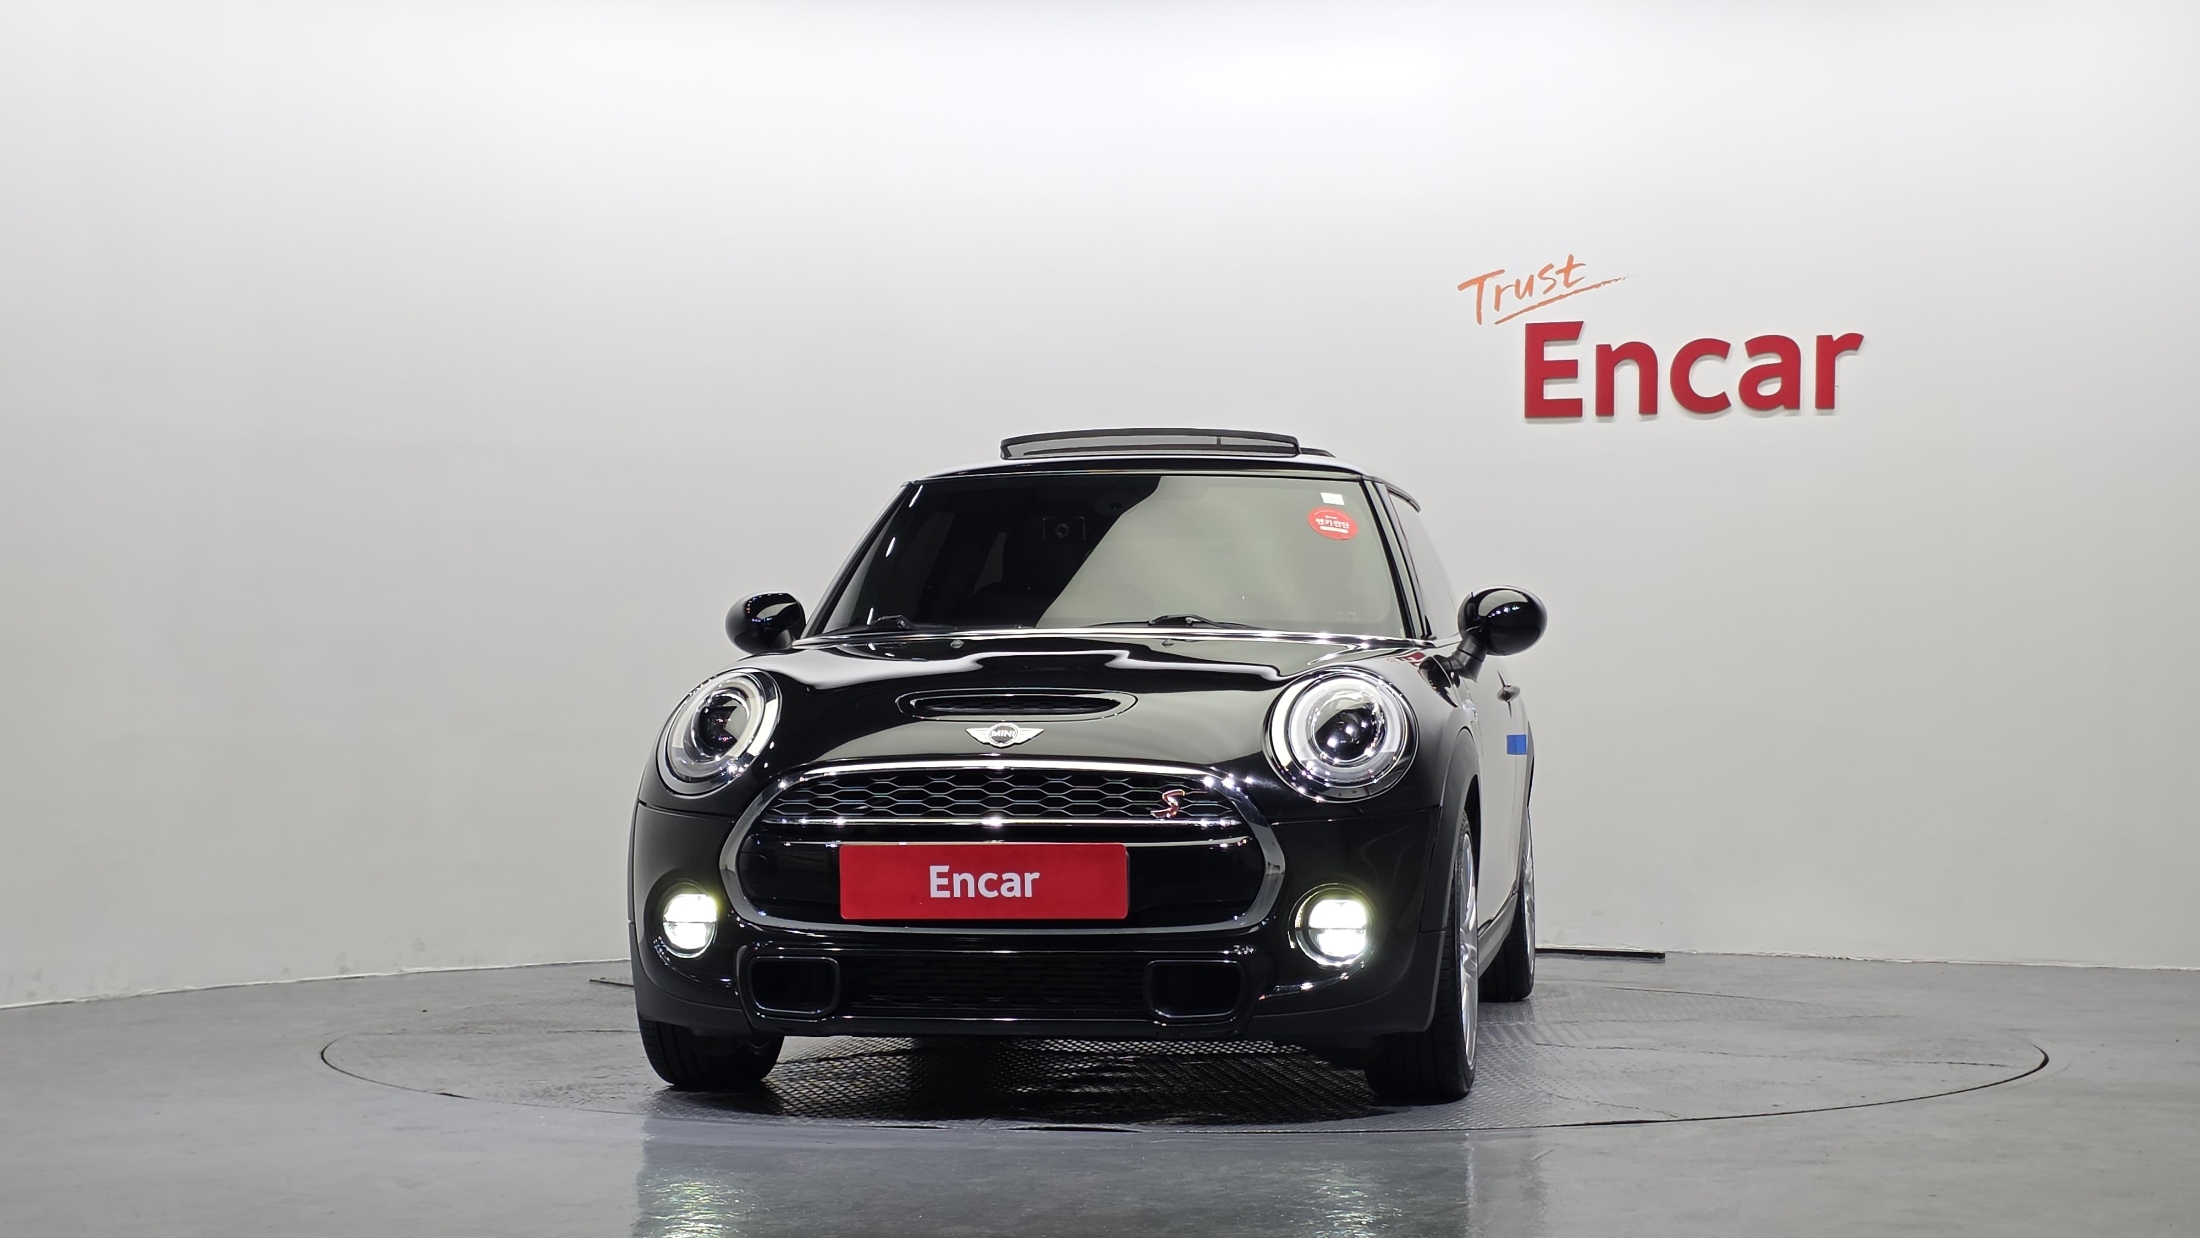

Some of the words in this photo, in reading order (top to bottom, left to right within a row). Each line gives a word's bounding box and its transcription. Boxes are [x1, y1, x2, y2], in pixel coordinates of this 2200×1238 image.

[1457, 253, 1587, 325] Trust
[1525, 321, 1864, 418] Encar
[991, 729, 1016, 738] MINI
[1150, 788, 1186, 818] S
[929, 865, 1040, 898] Encar
